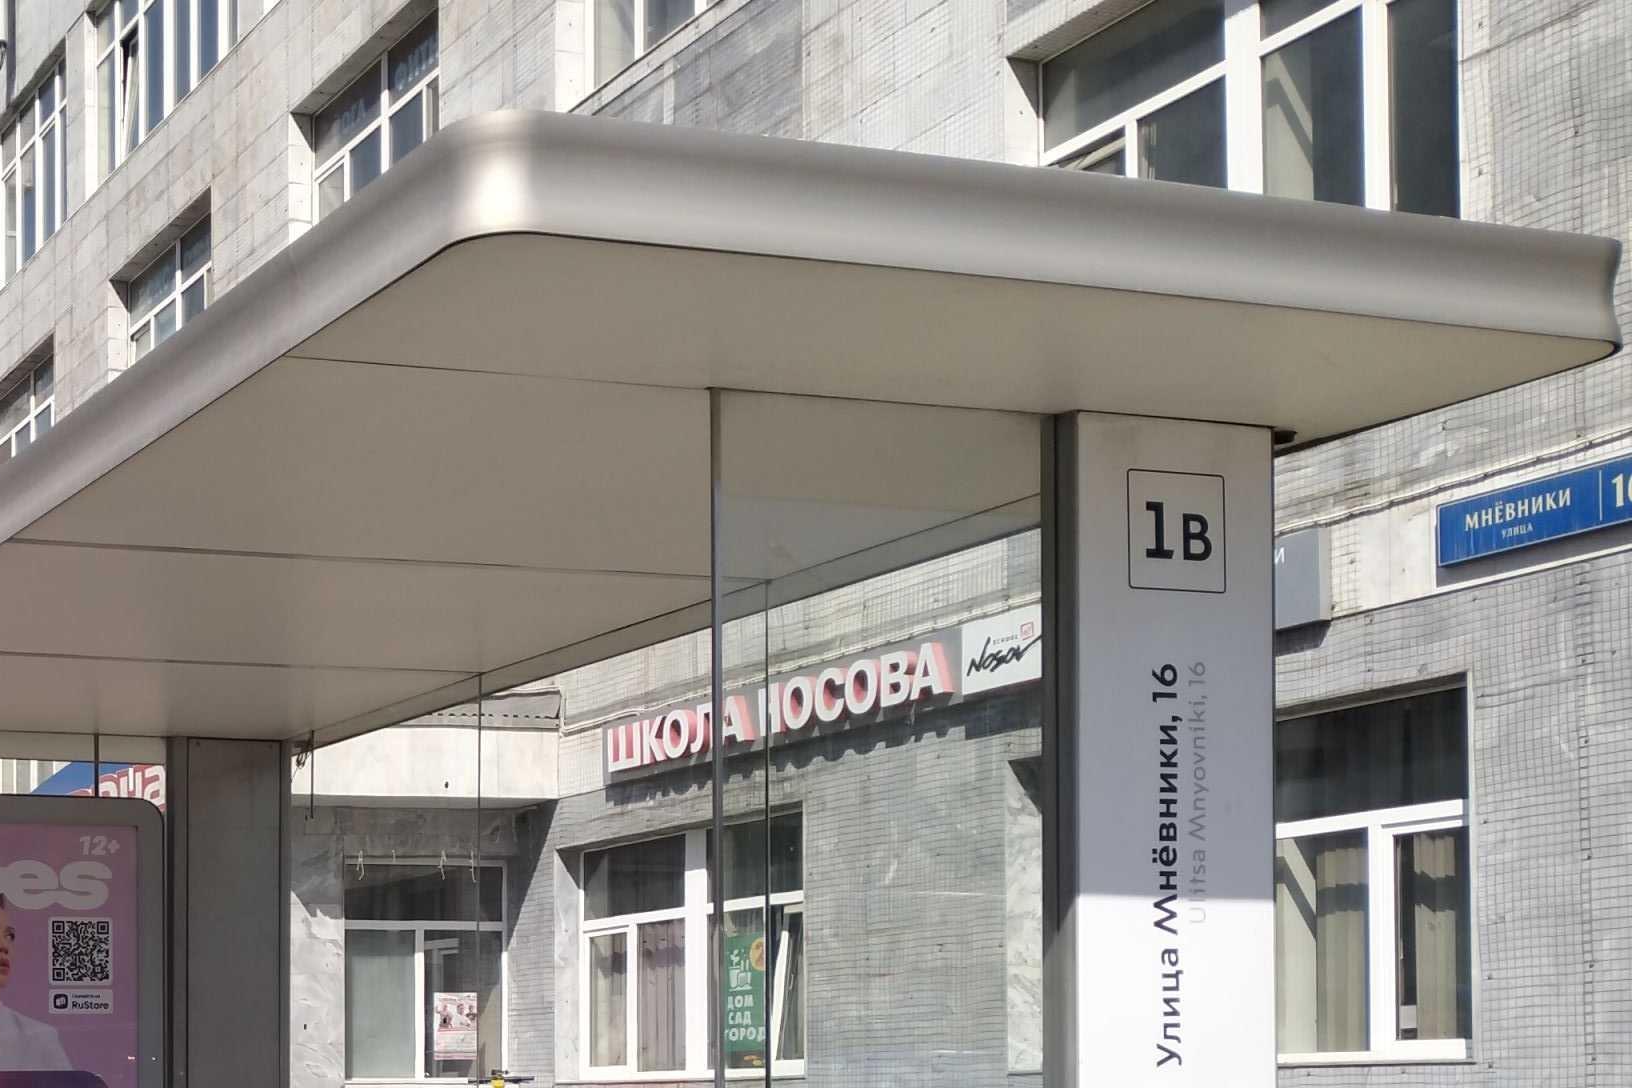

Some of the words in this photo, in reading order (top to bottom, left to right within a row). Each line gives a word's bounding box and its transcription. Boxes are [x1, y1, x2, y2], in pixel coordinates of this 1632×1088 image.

[1465, 487, 1572, 532] МНЁВНИКИ
[1611, 472, 1632, 508] 1
[1502, 523, 1534, 539] УЛИЦА
[1152, 664, 1179, 703] 16
[1188, 661, 1207, 688] 16
[607, 696, 751, 773] ШКОЛА
[759, 642, 949, 737] НОСОВА
[1188, 695, 1209, 841] Mnyovniki,
[1152, 713, 1183, 936] Мнёвники,
[79, 836, 120, 856] 12+
[72, 1001, 110, 1010] RuStore
[728, 993, 754, 1010] ДОМ
[728, 1010, 752, 1026] САД
[1156, 948, 1183, 1068] Улица
